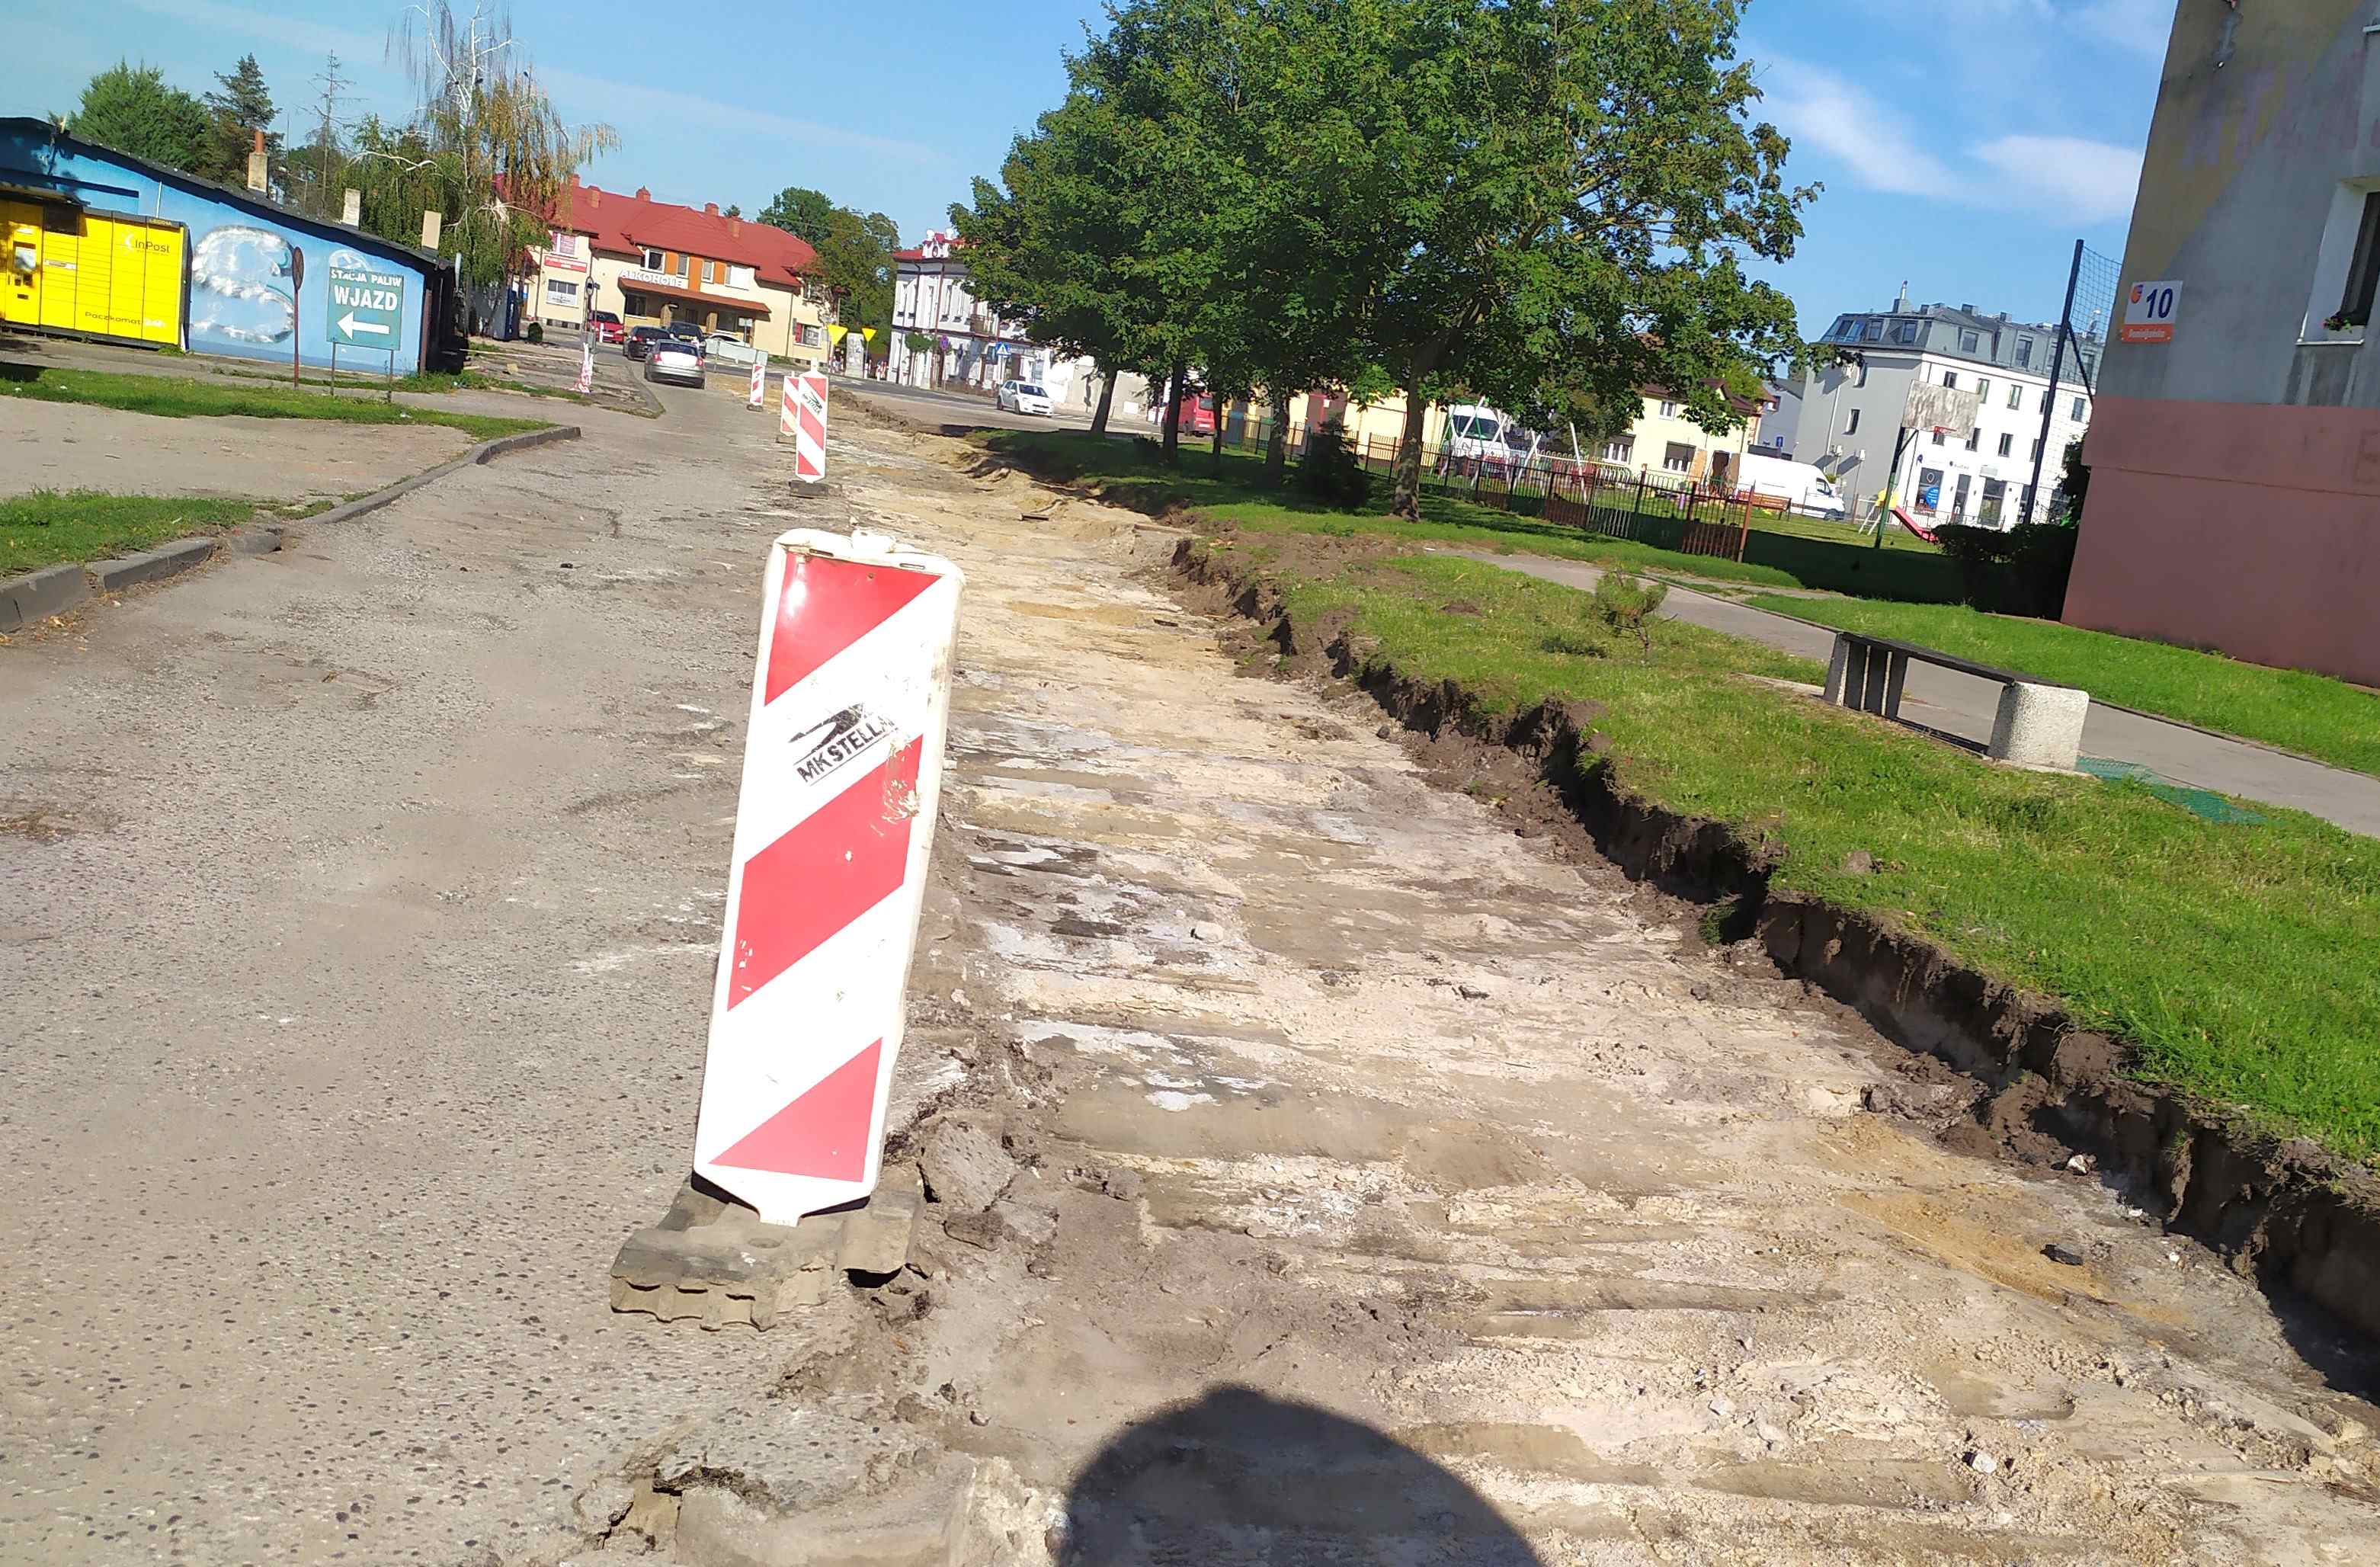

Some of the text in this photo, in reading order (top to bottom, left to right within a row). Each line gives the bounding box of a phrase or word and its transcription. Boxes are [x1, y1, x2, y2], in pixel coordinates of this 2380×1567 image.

[135, 239, 171, 253] InPost
[331, 269, 402, 287] STACJA PALIW
[620, 268, 684, 288] ALKOHOLE
[334, 285, 398, 311] WJAZD
[2146, 288, 2173, 319] 10
[85, 311, 141, 325] Paczkomat
[796, 751, 834, 783] MK
